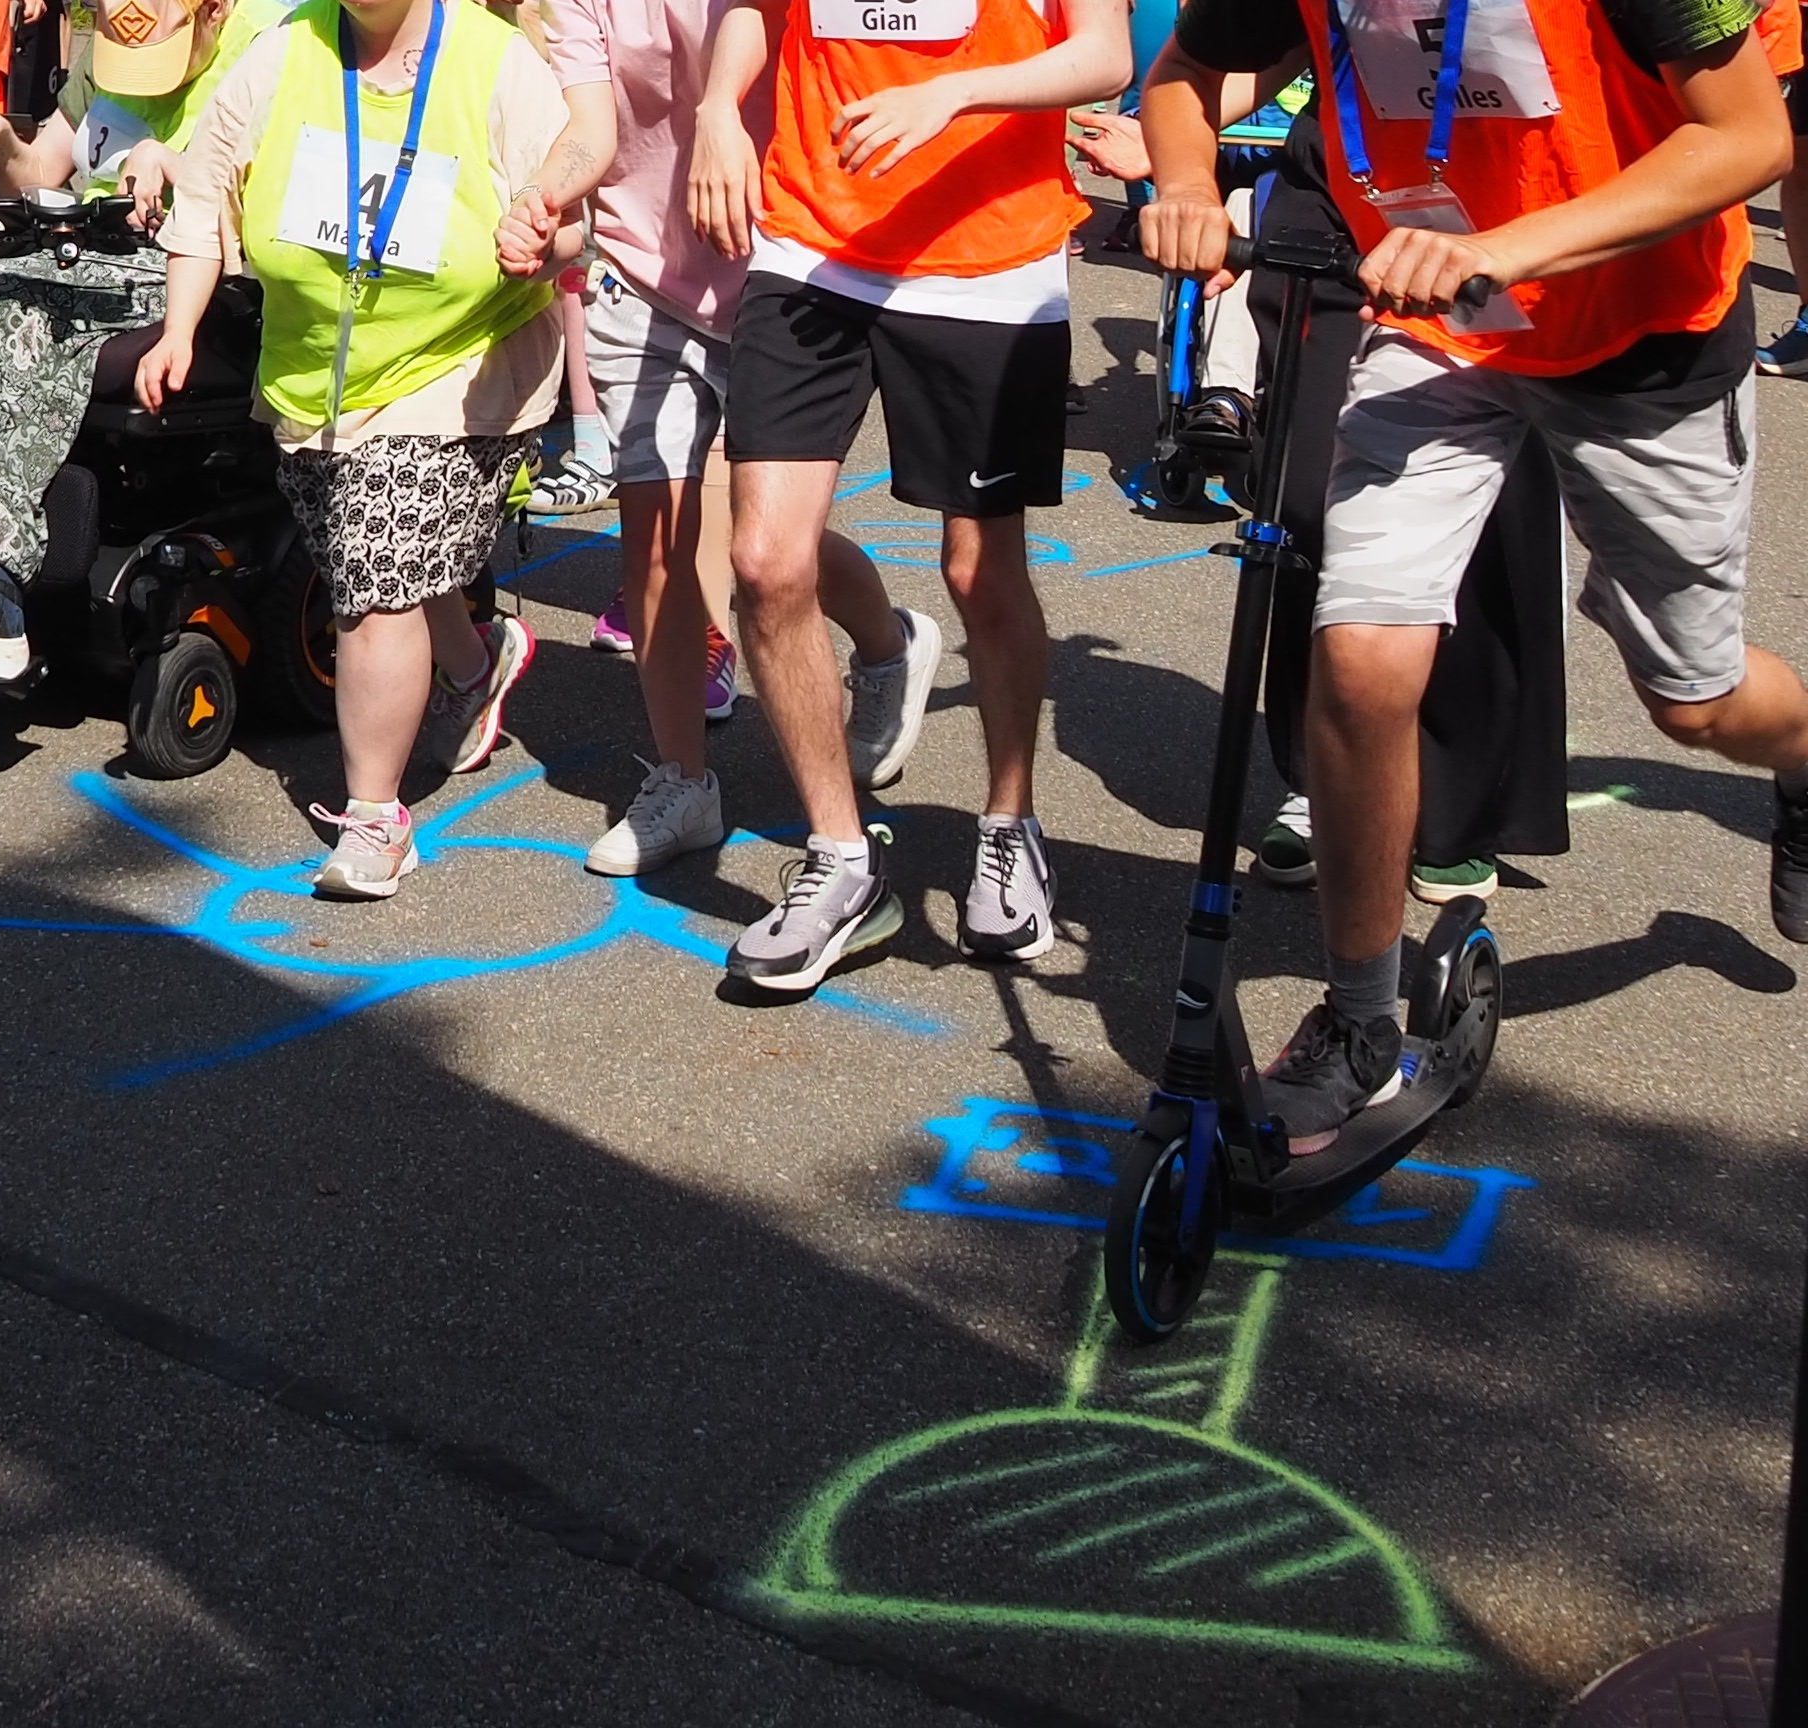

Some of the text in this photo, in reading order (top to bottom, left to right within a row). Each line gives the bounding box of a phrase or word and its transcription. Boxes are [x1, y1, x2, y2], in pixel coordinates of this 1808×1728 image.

[861, 6, 917, 31] Gian
[1416, 84, 1503, 110] Glles
[358, 172, 387, 226] 4
[316, 219, 401, 257] Maria
